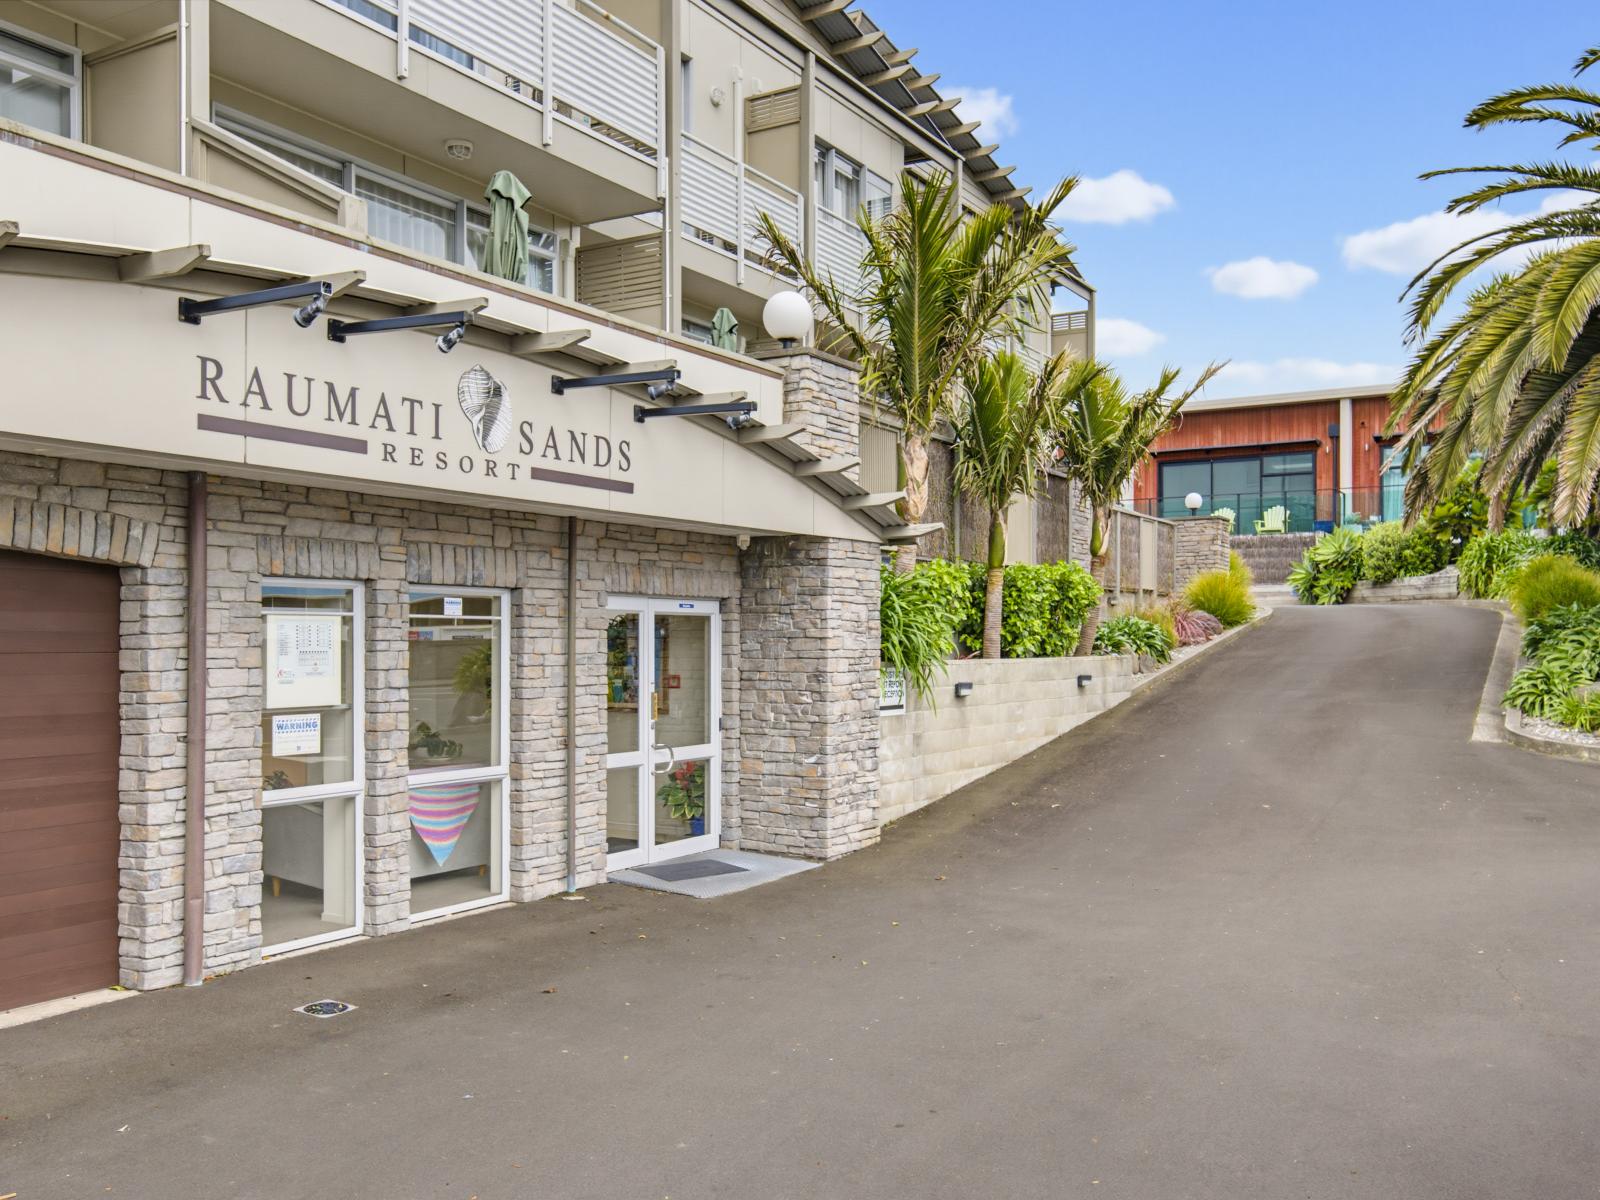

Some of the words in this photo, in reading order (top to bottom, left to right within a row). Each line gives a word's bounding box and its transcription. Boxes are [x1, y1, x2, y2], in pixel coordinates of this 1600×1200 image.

[196, 355, 443, 440] RAUMATI
[518, 420, 632, 472] SANDS
[381, 443, 520, 480] RESORT
[276, 721, 318, 732] WARNING
